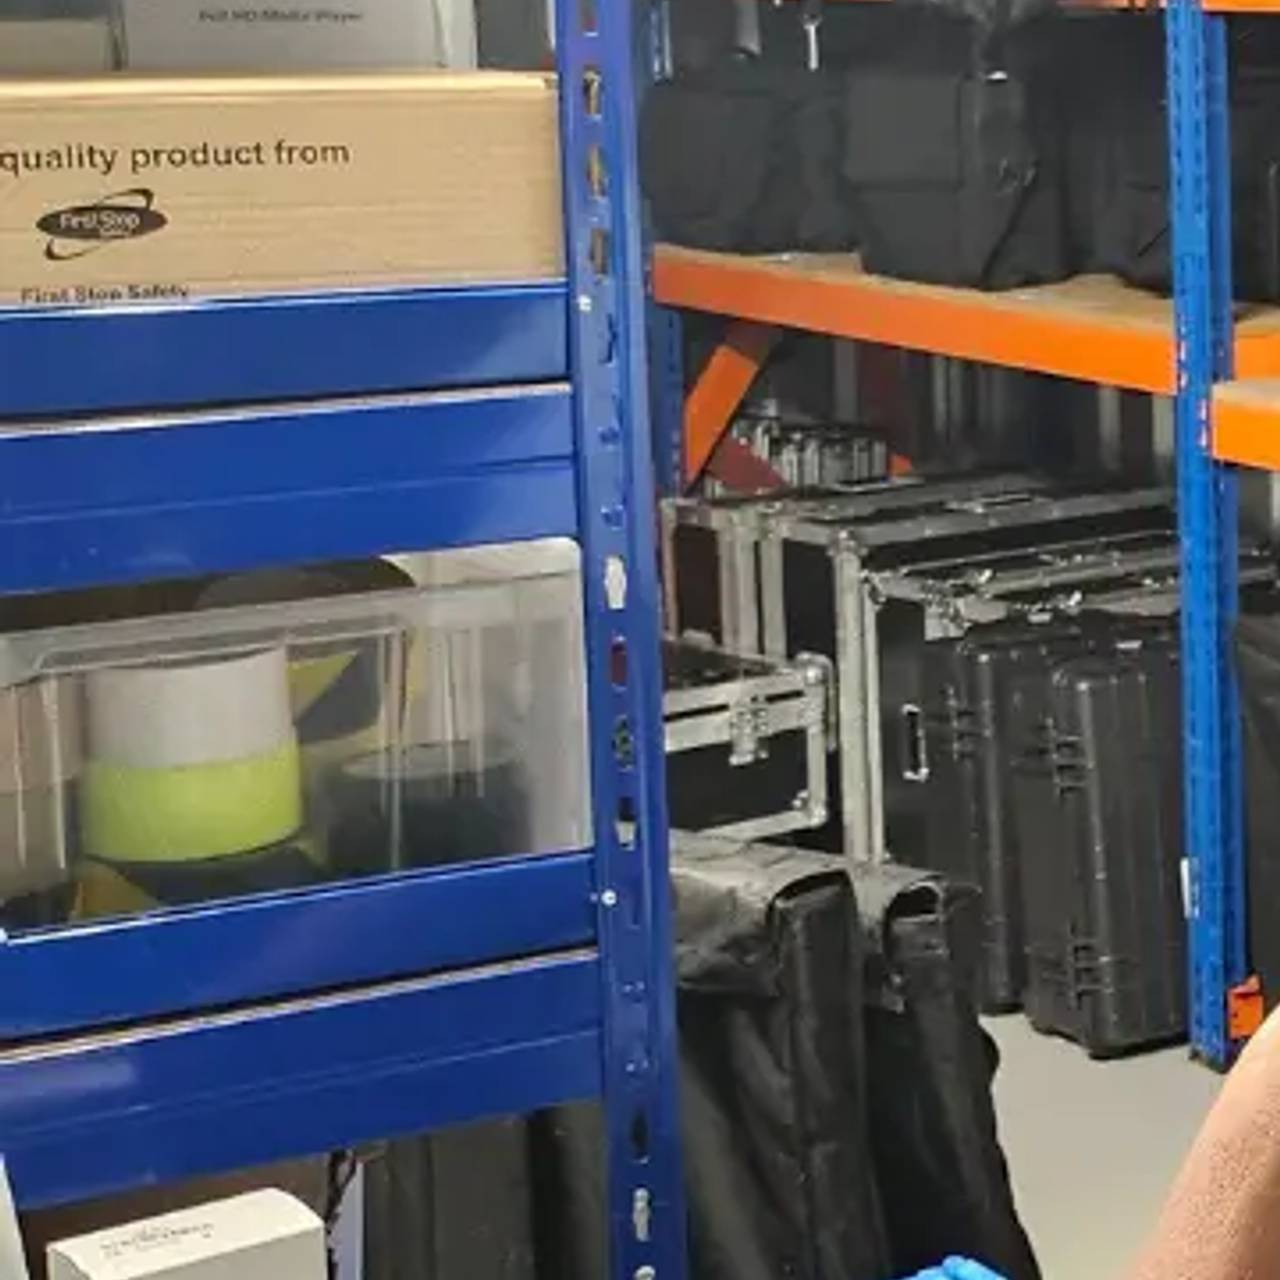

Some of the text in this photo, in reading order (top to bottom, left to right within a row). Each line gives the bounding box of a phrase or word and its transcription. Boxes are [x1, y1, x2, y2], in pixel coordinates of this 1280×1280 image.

[0, 138, 350, 176] quality product from
[21, 283, 189, 305] First Stop Safety
